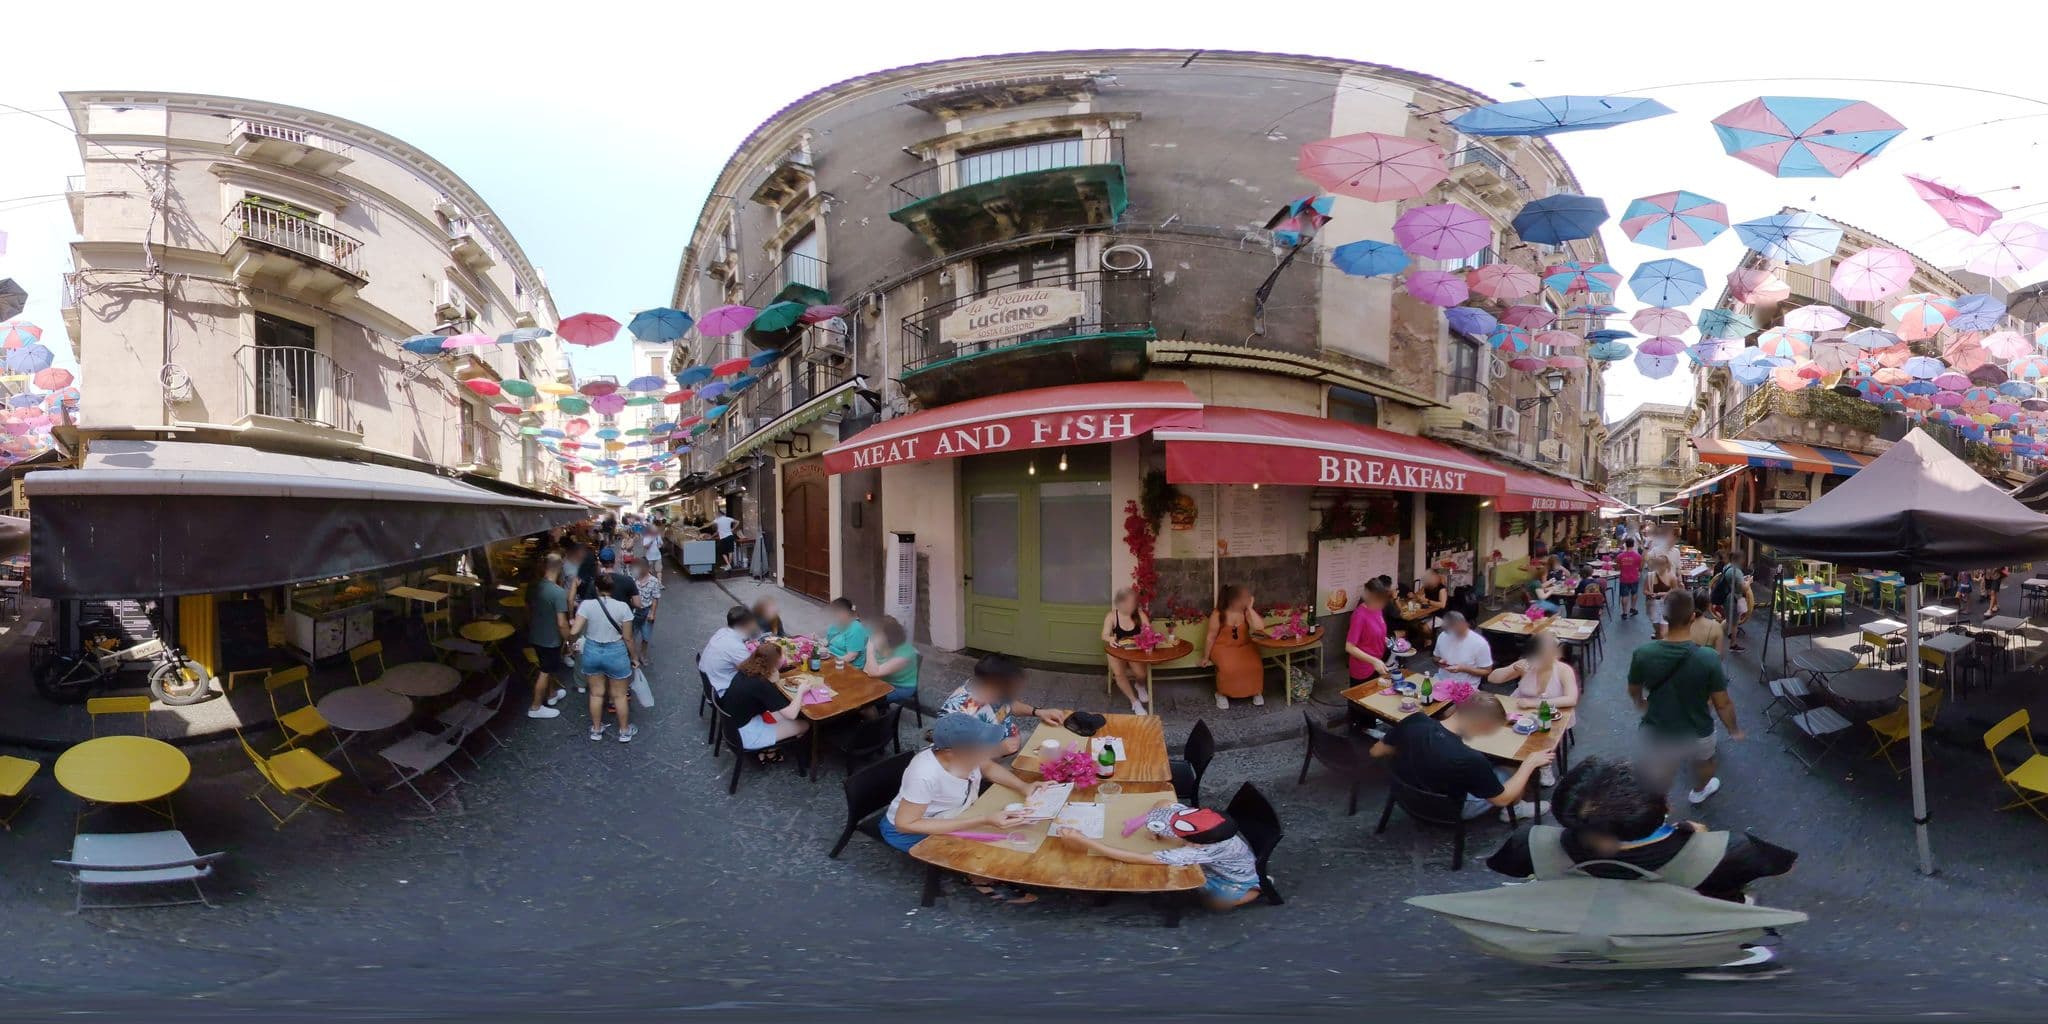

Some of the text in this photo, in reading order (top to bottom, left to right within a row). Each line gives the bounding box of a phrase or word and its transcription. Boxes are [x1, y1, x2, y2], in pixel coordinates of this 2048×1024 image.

[988, 290, 1048, 310] Locanda
[969, 304, 1048, 330] LUCIANO
[1005, 321, 1035, 334] RISTORO
[853, 413, 1134, 468] MEAT AND FISH
[1318, 455, 1467, 491] BREAKFAST
[1532, 497, 1557, 509] BURGER
